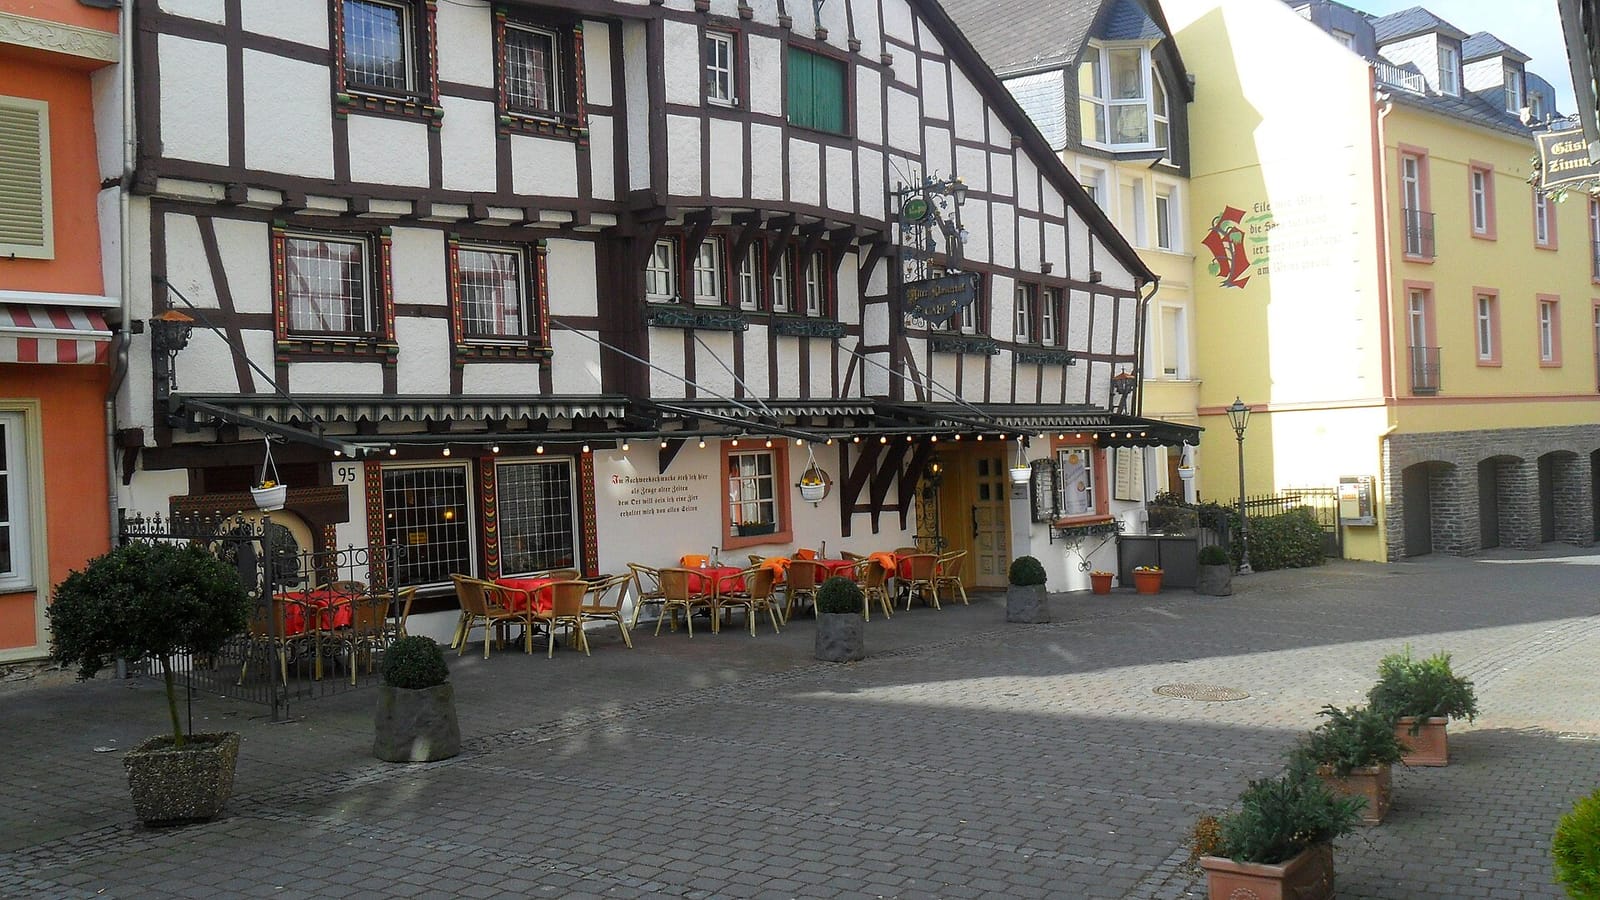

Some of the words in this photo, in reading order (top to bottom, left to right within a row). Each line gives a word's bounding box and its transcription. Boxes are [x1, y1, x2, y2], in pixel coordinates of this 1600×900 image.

[1253, 202, 1271, 213] Eile
[1249, 224, 1262, 234] die
[338, 467, 356, 482] 95
